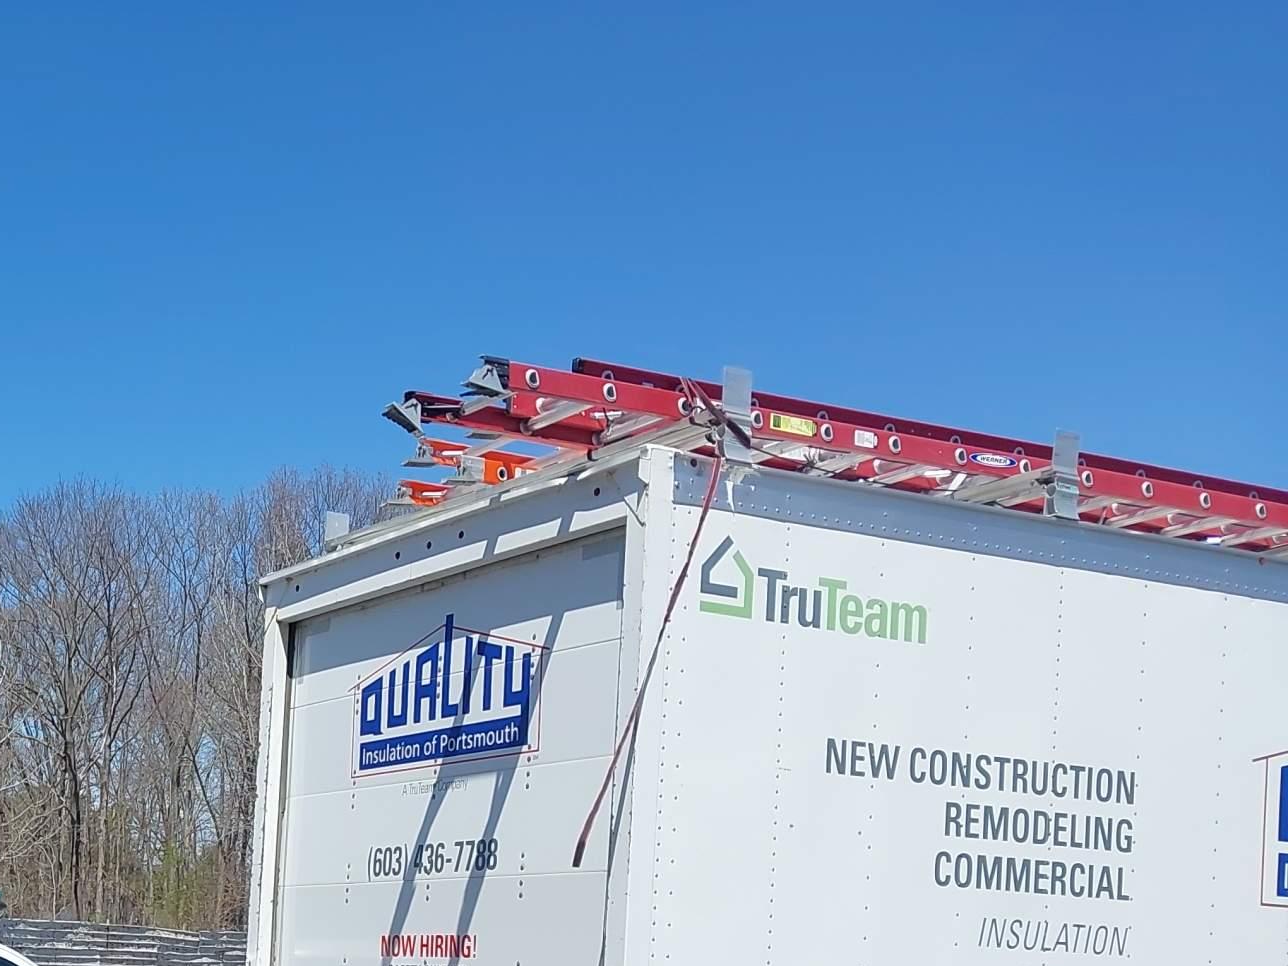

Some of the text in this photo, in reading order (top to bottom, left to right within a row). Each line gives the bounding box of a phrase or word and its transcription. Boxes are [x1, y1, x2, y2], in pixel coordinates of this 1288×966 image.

[980, 455, 1008, 465] WERNER
[757, 567, 928, 645] TruTeam
[360, 613, 532, 742] QUALITY
[362, 722, 520, 766] Insulation of Portsmouth
[825, 738, 1136, 805] NEW CONSTRUCTION
[944, 801, 1134, 853] REMODELING
[368, 838, 498, 882] (603) 436-7788
[934, 851, 1131, 901] COMMERCIAL
[380, 934, 477, 959] NOW HIRING!
[978, 917, 1129, 956] INSULATION
